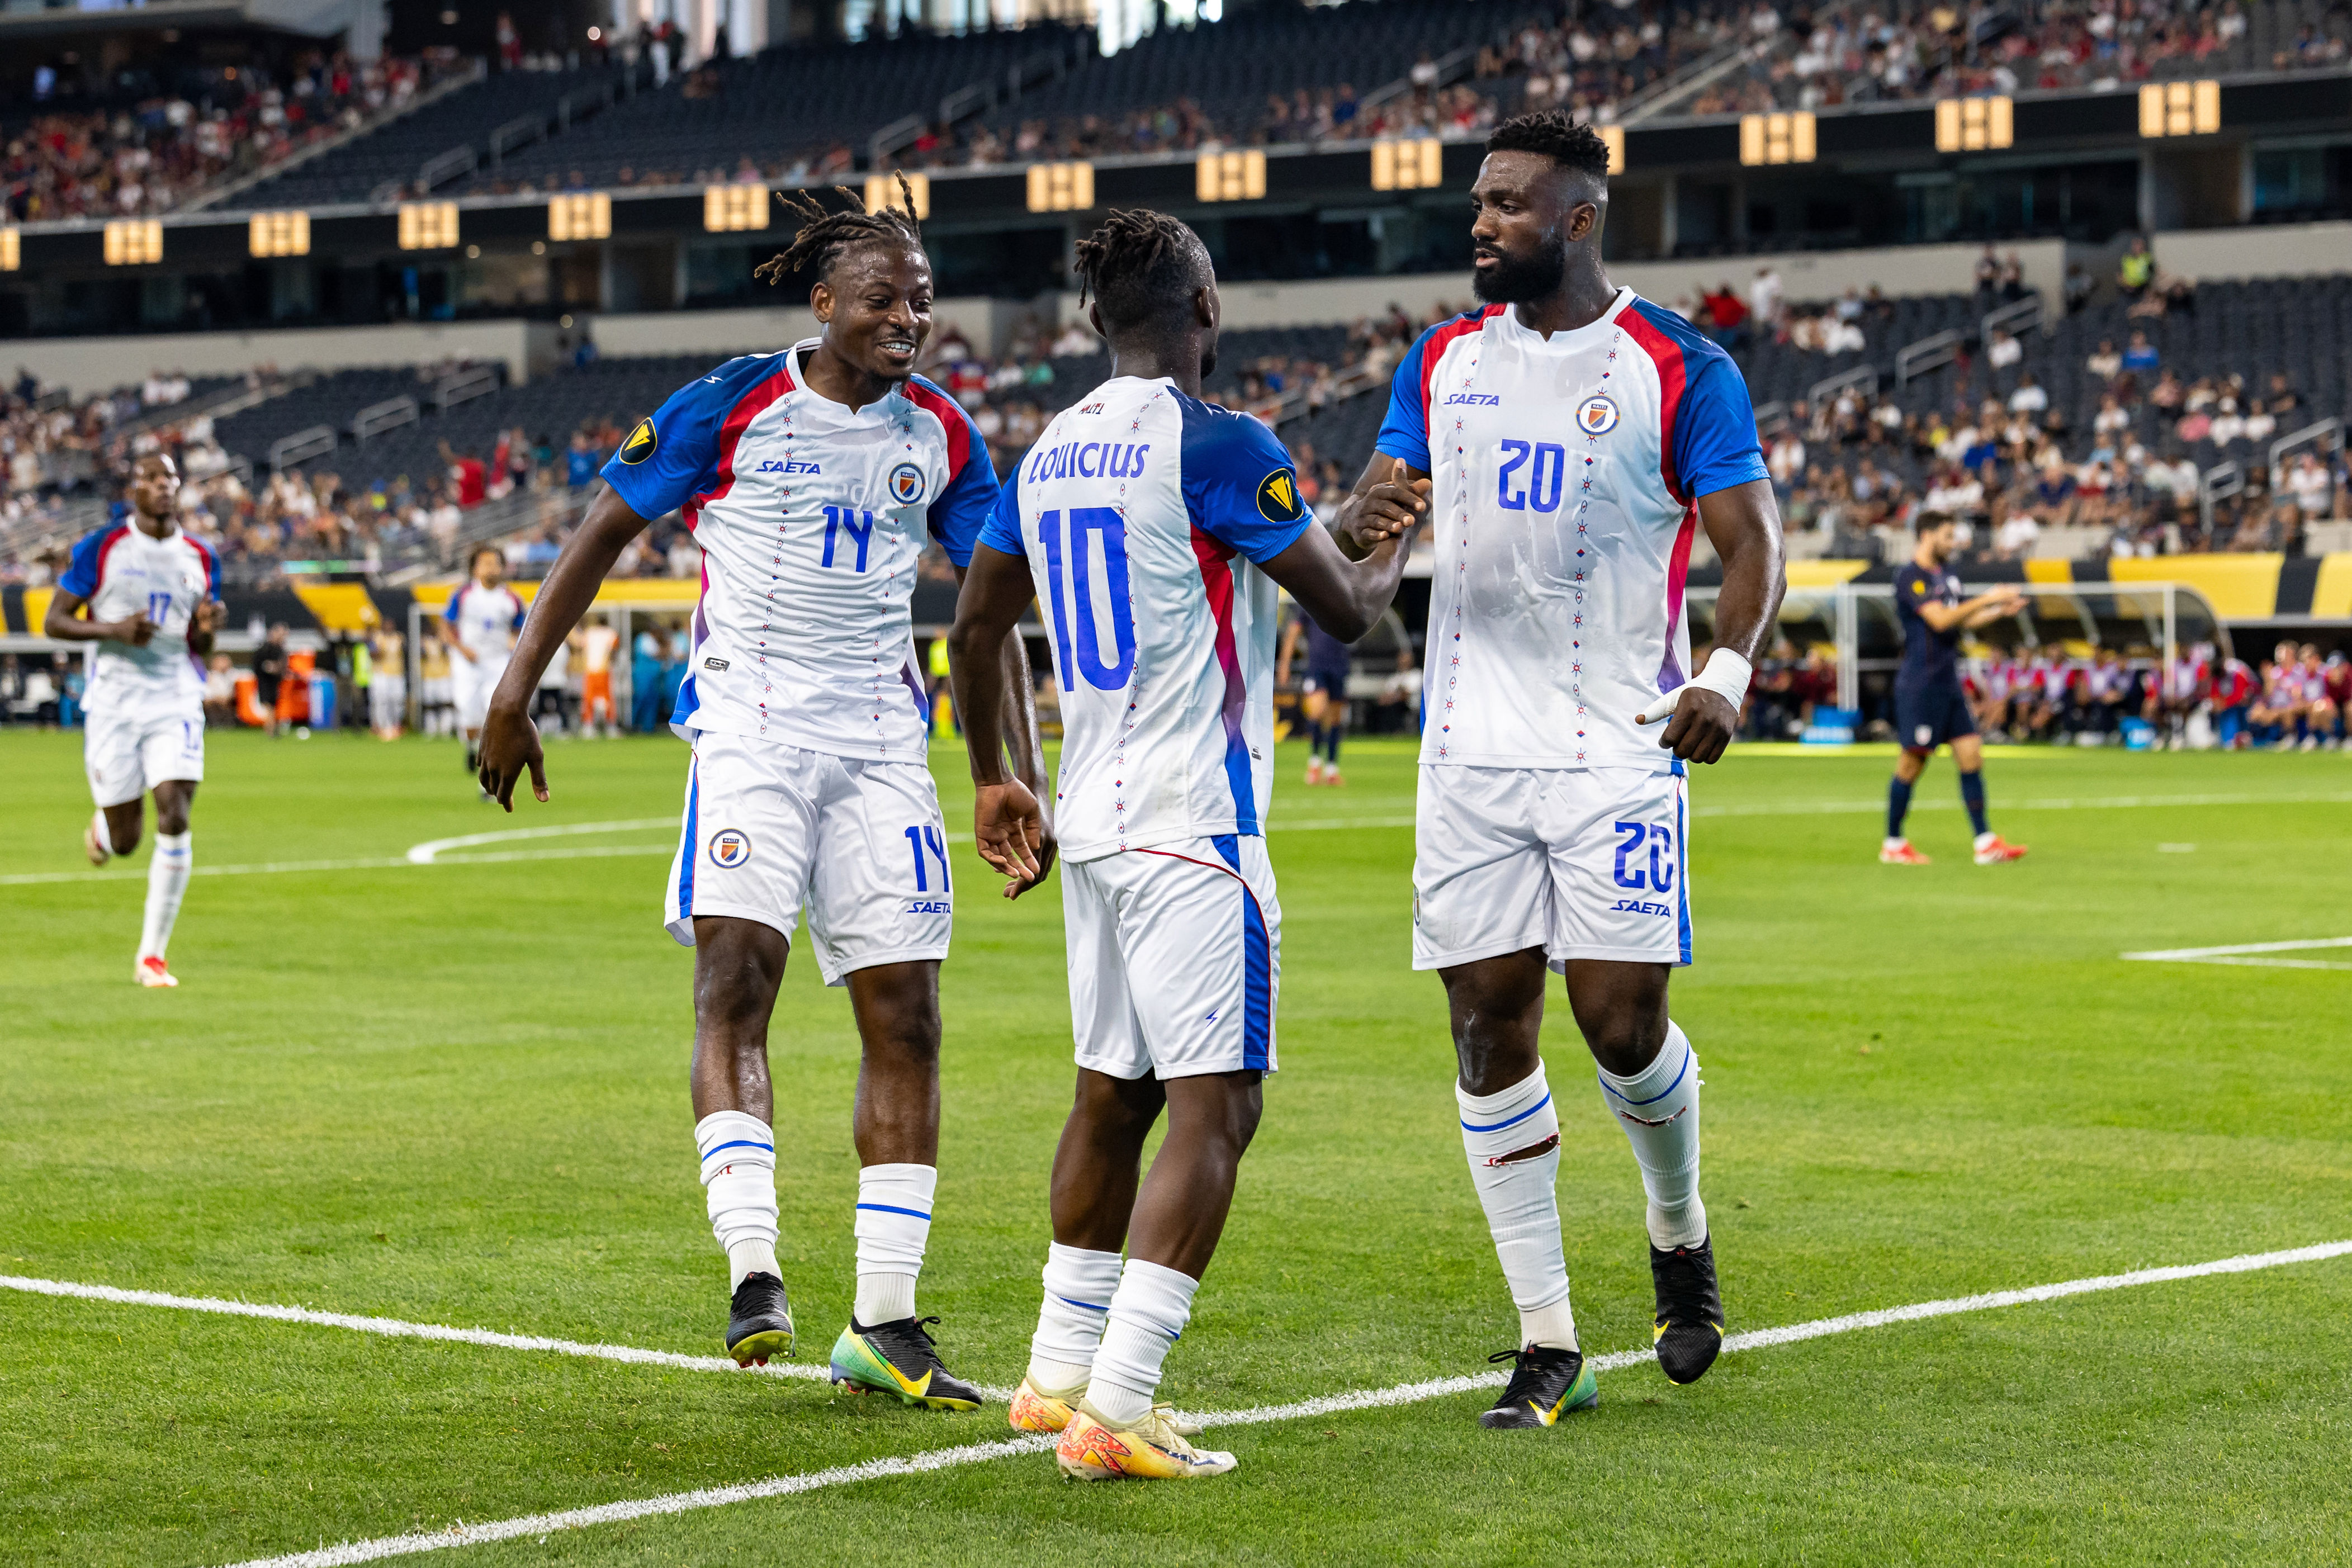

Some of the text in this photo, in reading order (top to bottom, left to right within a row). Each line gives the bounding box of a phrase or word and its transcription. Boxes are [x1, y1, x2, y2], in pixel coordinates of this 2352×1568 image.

[1443, 394, 1499, 406] SAETA
[755, 461, 821, 475] SAETA
[1028, 442, 1151, 484] LOUICIUS
[1498, 439, 1565, 513] 20
[821, 505, 873, 573] 14
[149, 591, 173, 626] 17
[1038, 507, 1135, 692] 10
[1613, 821, 1673, 893] 20
[906, 902, 951, 914] SAETA
[1609, 899, 1670, 918] SAETA
